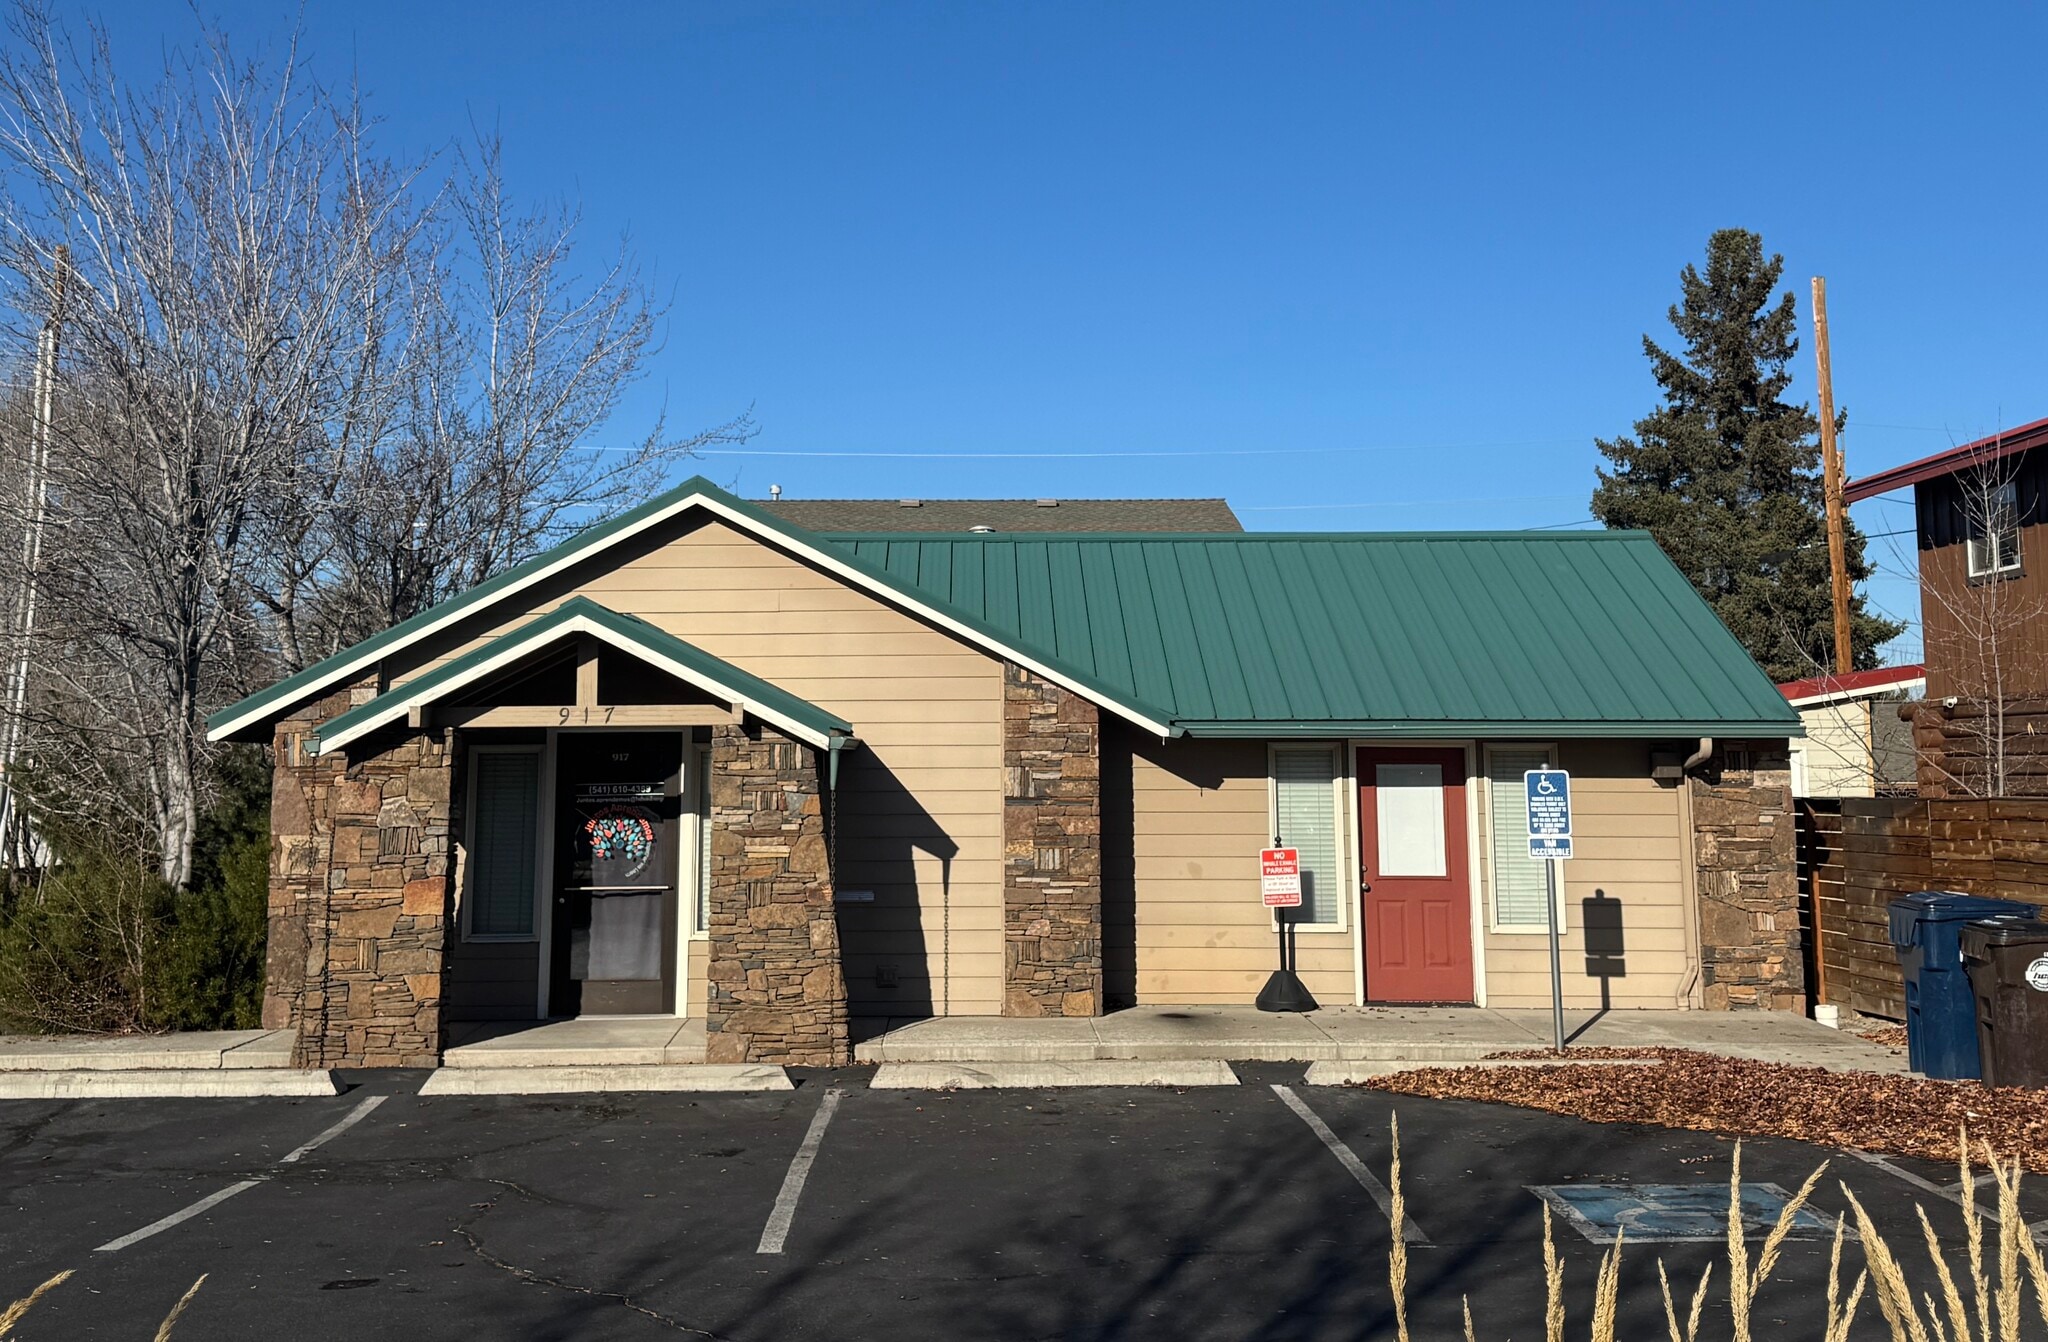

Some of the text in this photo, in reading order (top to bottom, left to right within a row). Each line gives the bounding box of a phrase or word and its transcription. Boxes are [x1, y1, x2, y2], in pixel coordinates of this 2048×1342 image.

[559, 706, 615, 725] 917
[612, 753, 629, 761] 917
[589, 785, 610, 794] (541)
[1544, 839, 1557, 848] VAN
[1273, 851, 1285, 860] NO
[1531, 848, 1570, 856] ACCESSIBLE
[1265, 866, 1294, 874] PARKING
